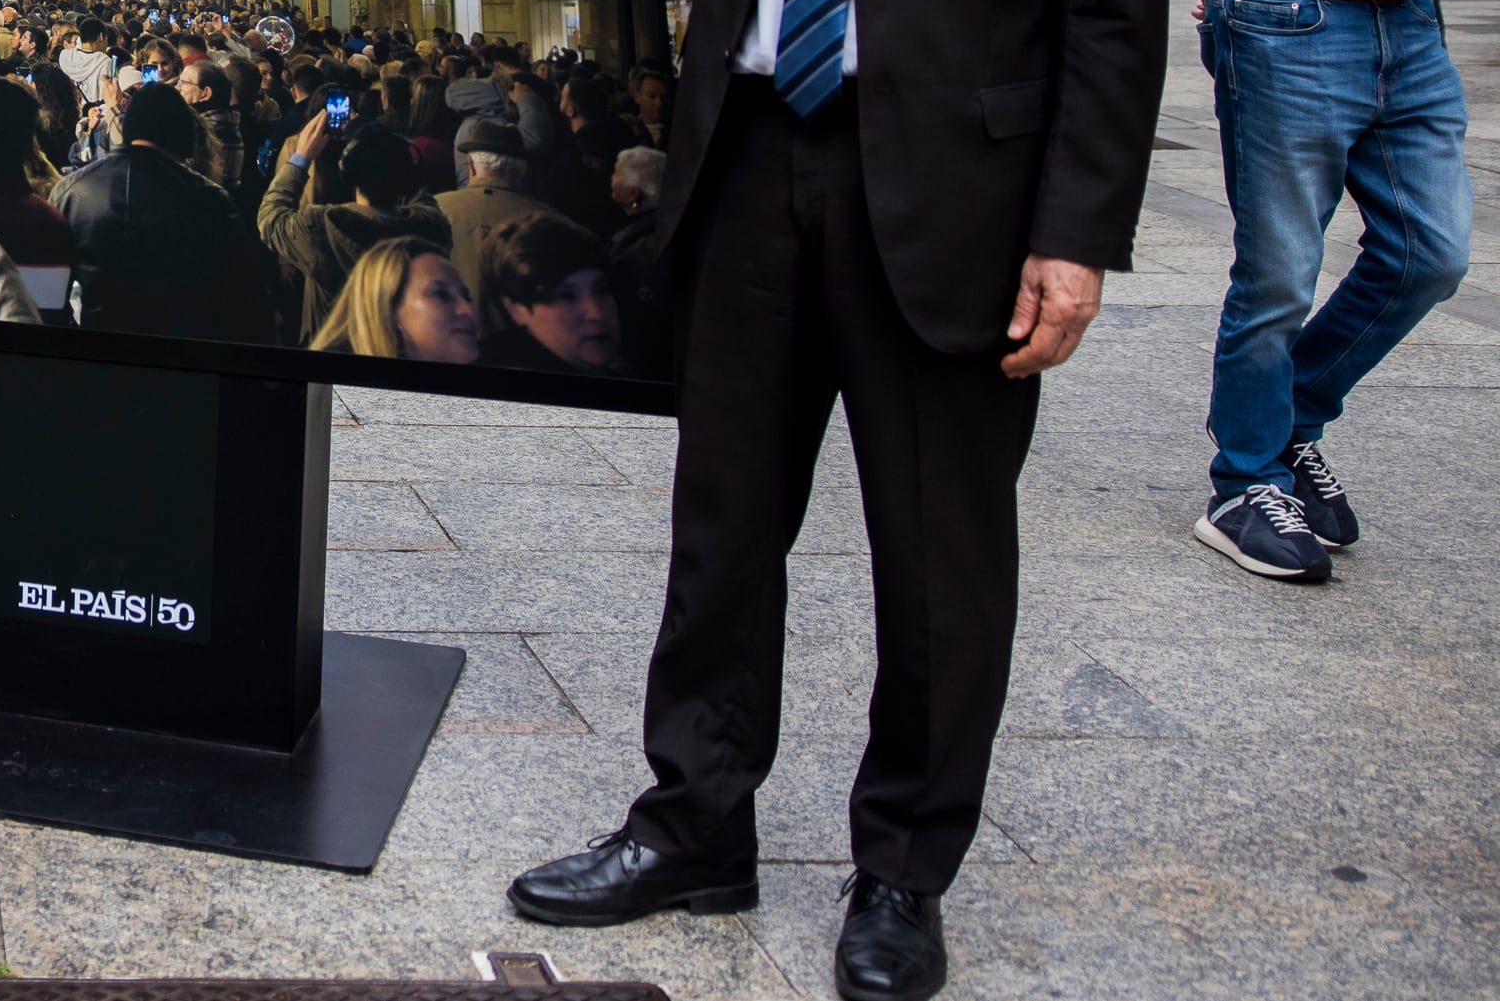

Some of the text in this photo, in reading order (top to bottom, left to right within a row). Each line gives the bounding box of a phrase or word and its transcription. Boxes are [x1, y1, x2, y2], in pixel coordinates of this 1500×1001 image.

[18, 581, 196, 631] EL PAÍS 50
